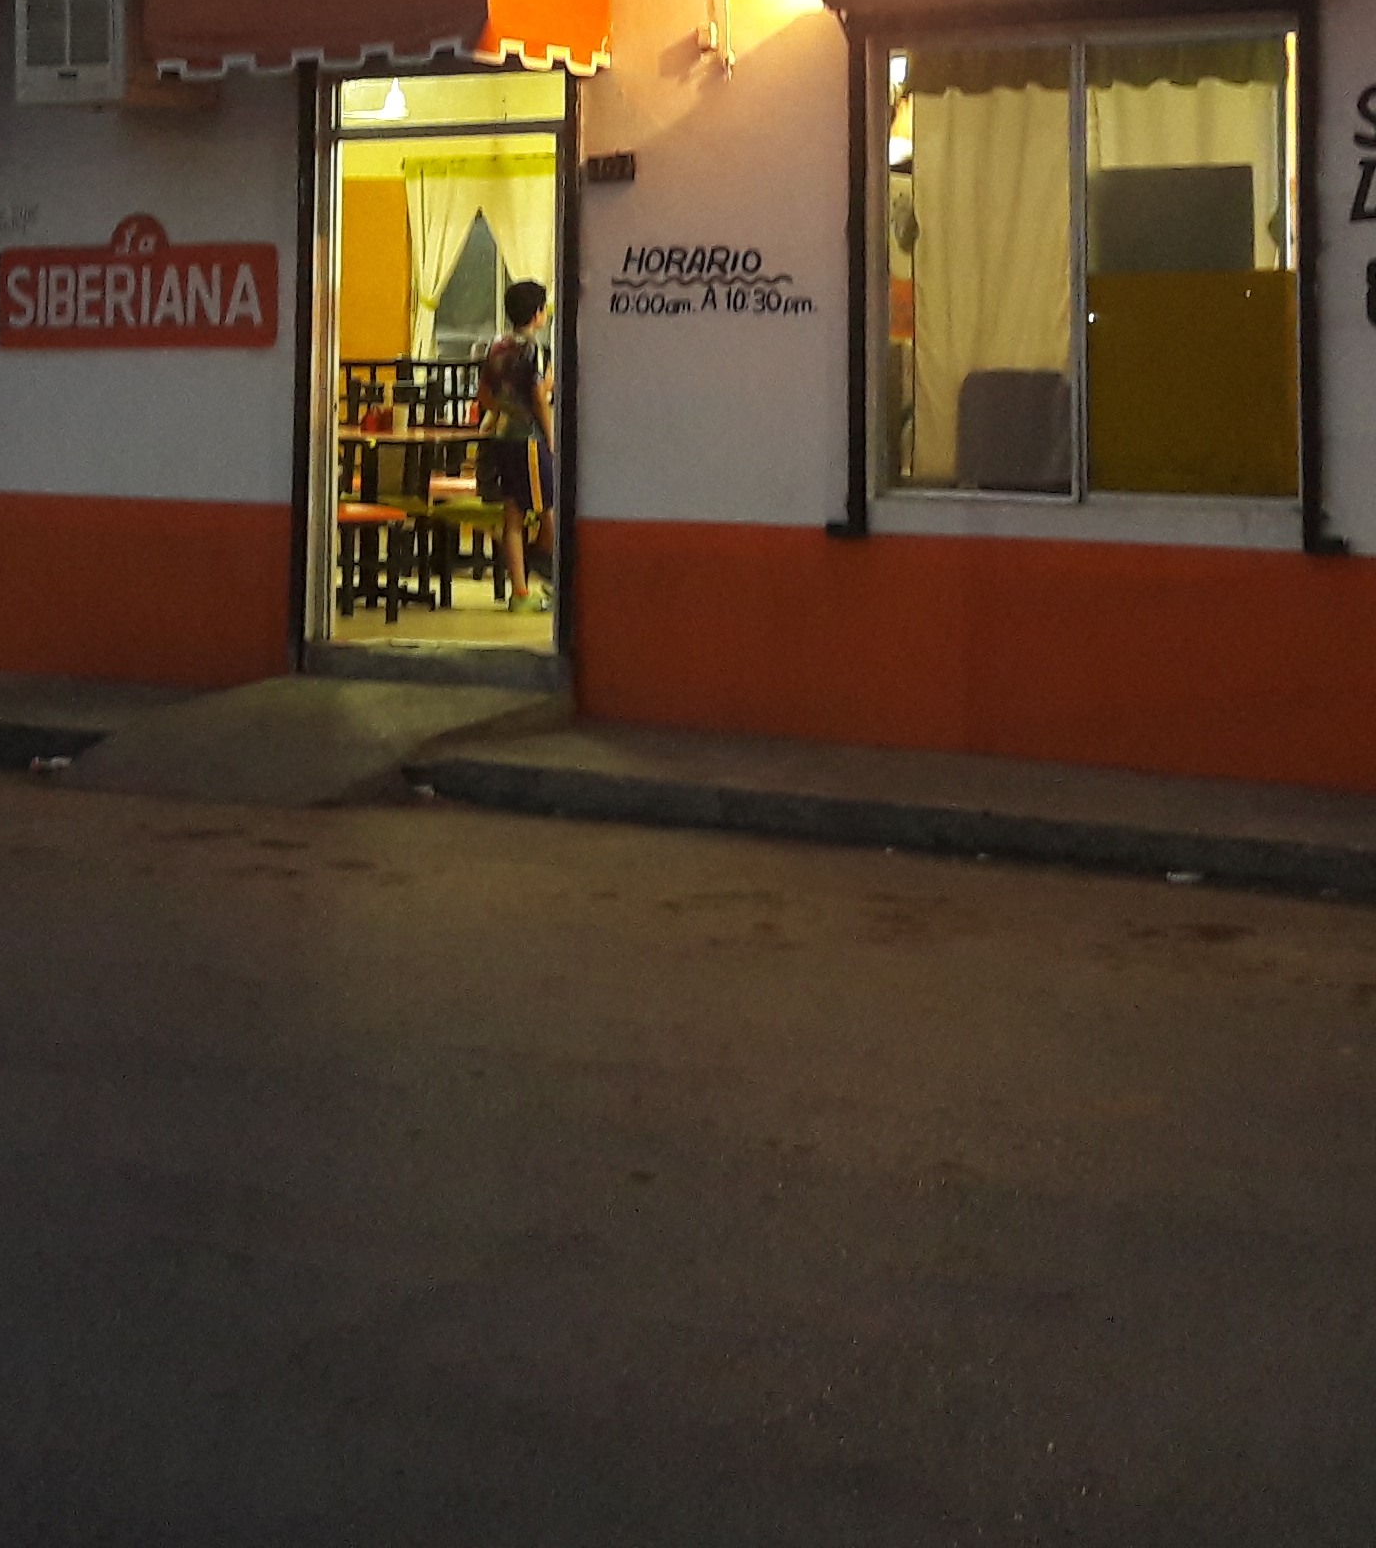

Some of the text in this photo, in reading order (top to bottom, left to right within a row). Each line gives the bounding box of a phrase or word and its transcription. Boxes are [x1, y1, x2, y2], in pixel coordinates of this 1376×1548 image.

[622, 245, 763, 276] HORARIO
[6, 262, 263, 330] SIBERIANA
[701, 284, 718, 312] A
